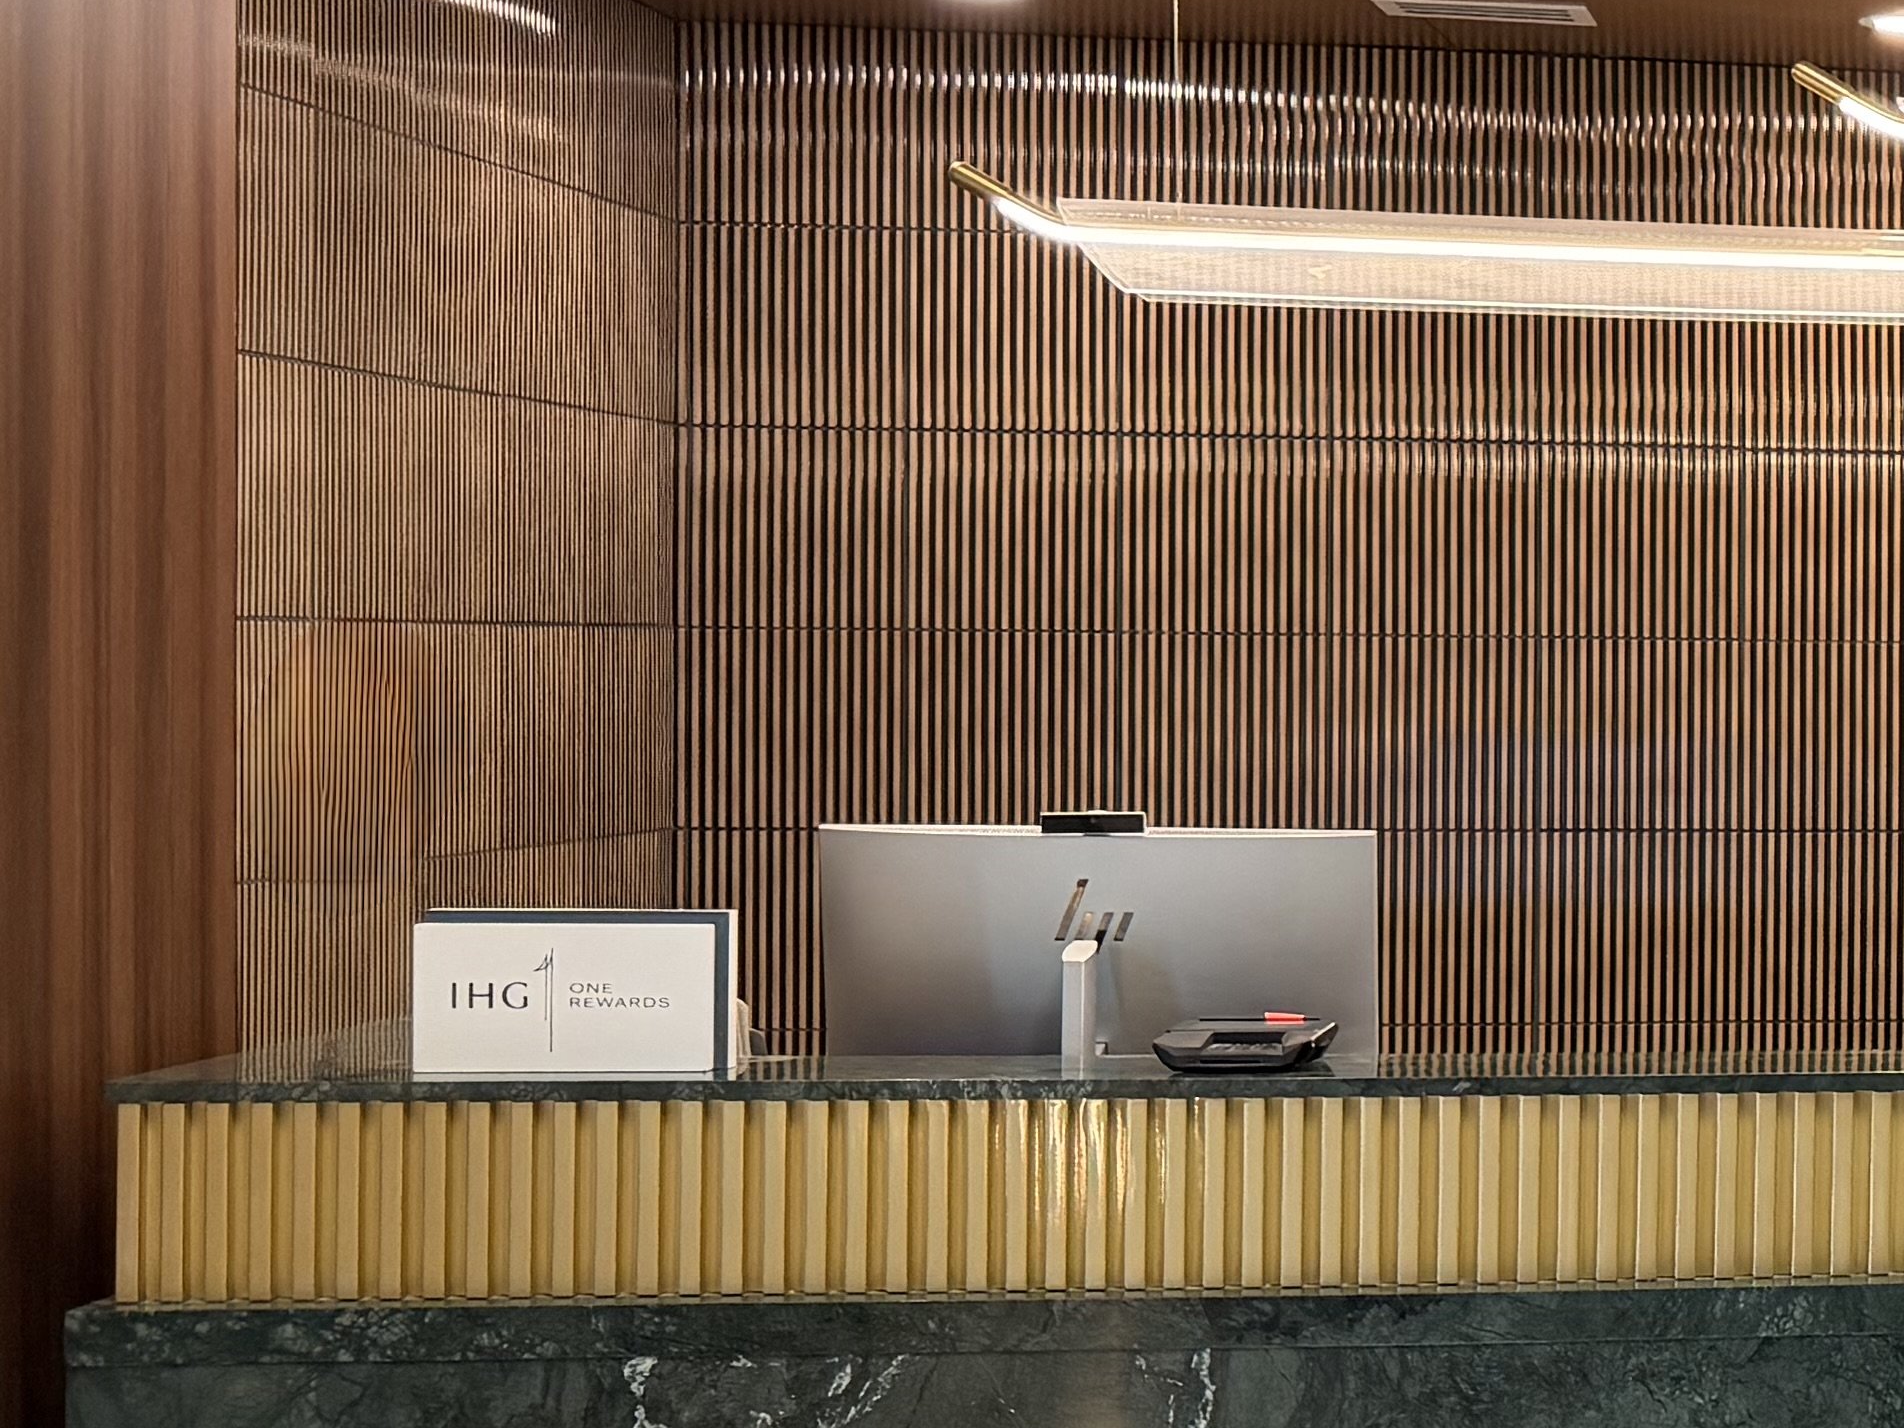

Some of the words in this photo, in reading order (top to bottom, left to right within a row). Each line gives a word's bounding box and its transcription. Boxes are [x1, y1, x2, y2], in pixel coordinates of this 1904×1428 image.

[569, 983, 613, 994] ONE
[451, 981, 529, 1009] IHG
[569, 997, 670, 1008] REWARDS
